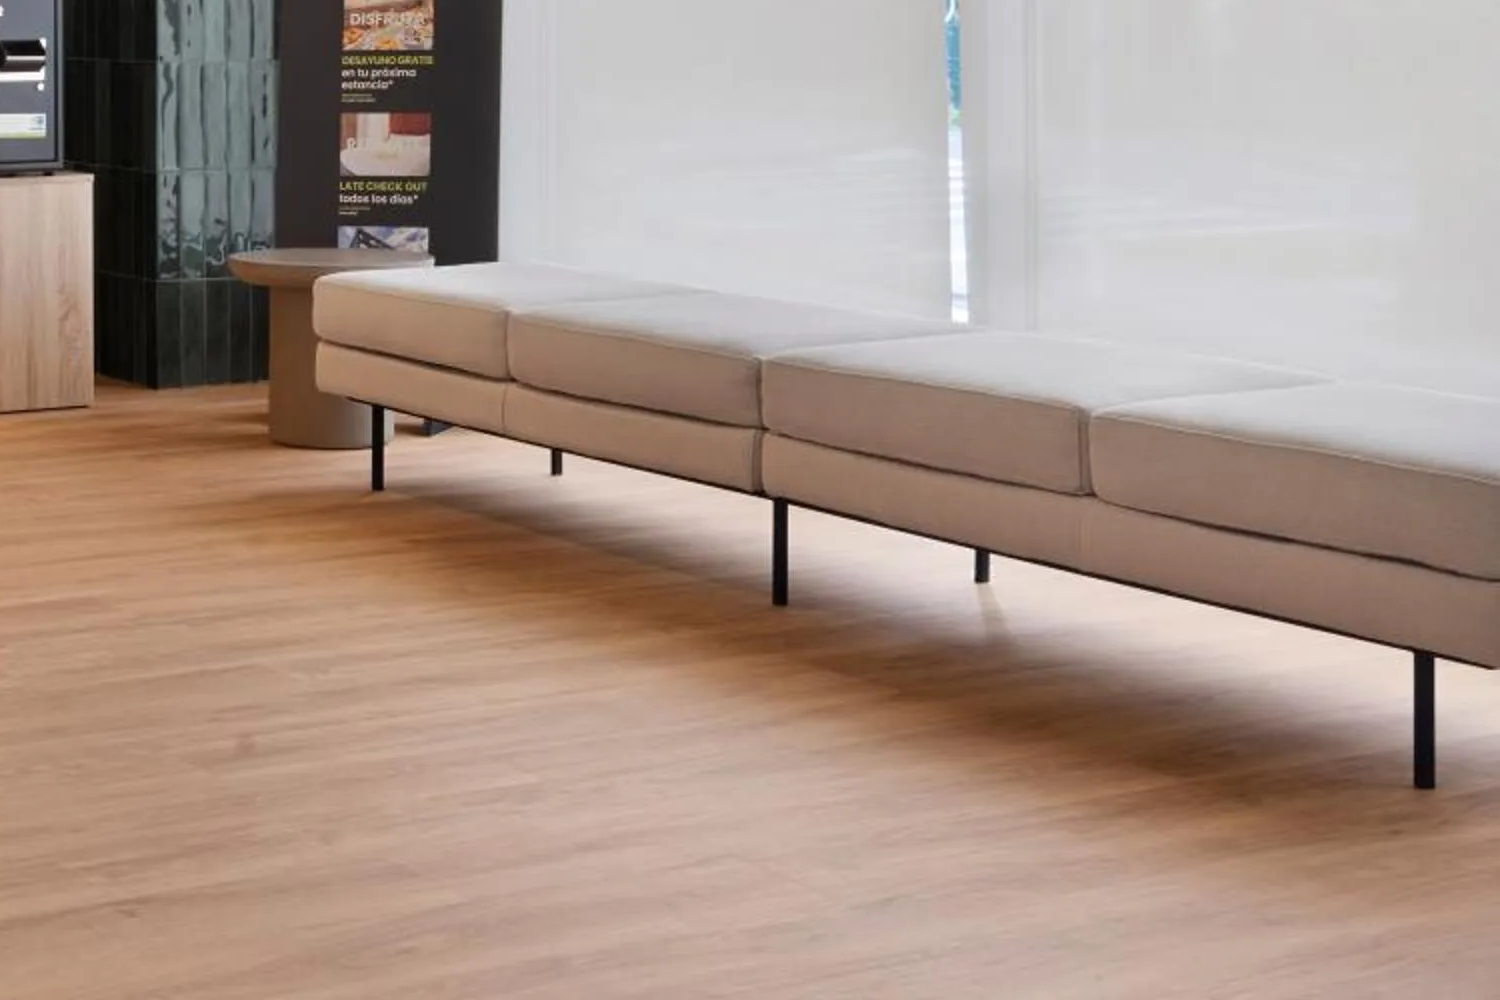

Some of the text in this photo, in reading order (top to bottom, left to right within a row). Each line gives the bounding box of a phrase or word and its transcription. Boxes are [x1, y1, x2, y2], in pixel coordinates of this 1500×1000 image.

[341, 68, 356, 77] en
[358, 68, 369, 77] tu
[339, 181, 366, 191] LATE
[405, 181, 428, 192] OUT
[339, 193, 369, 203] todos
[371, 193, 388, 203] los
